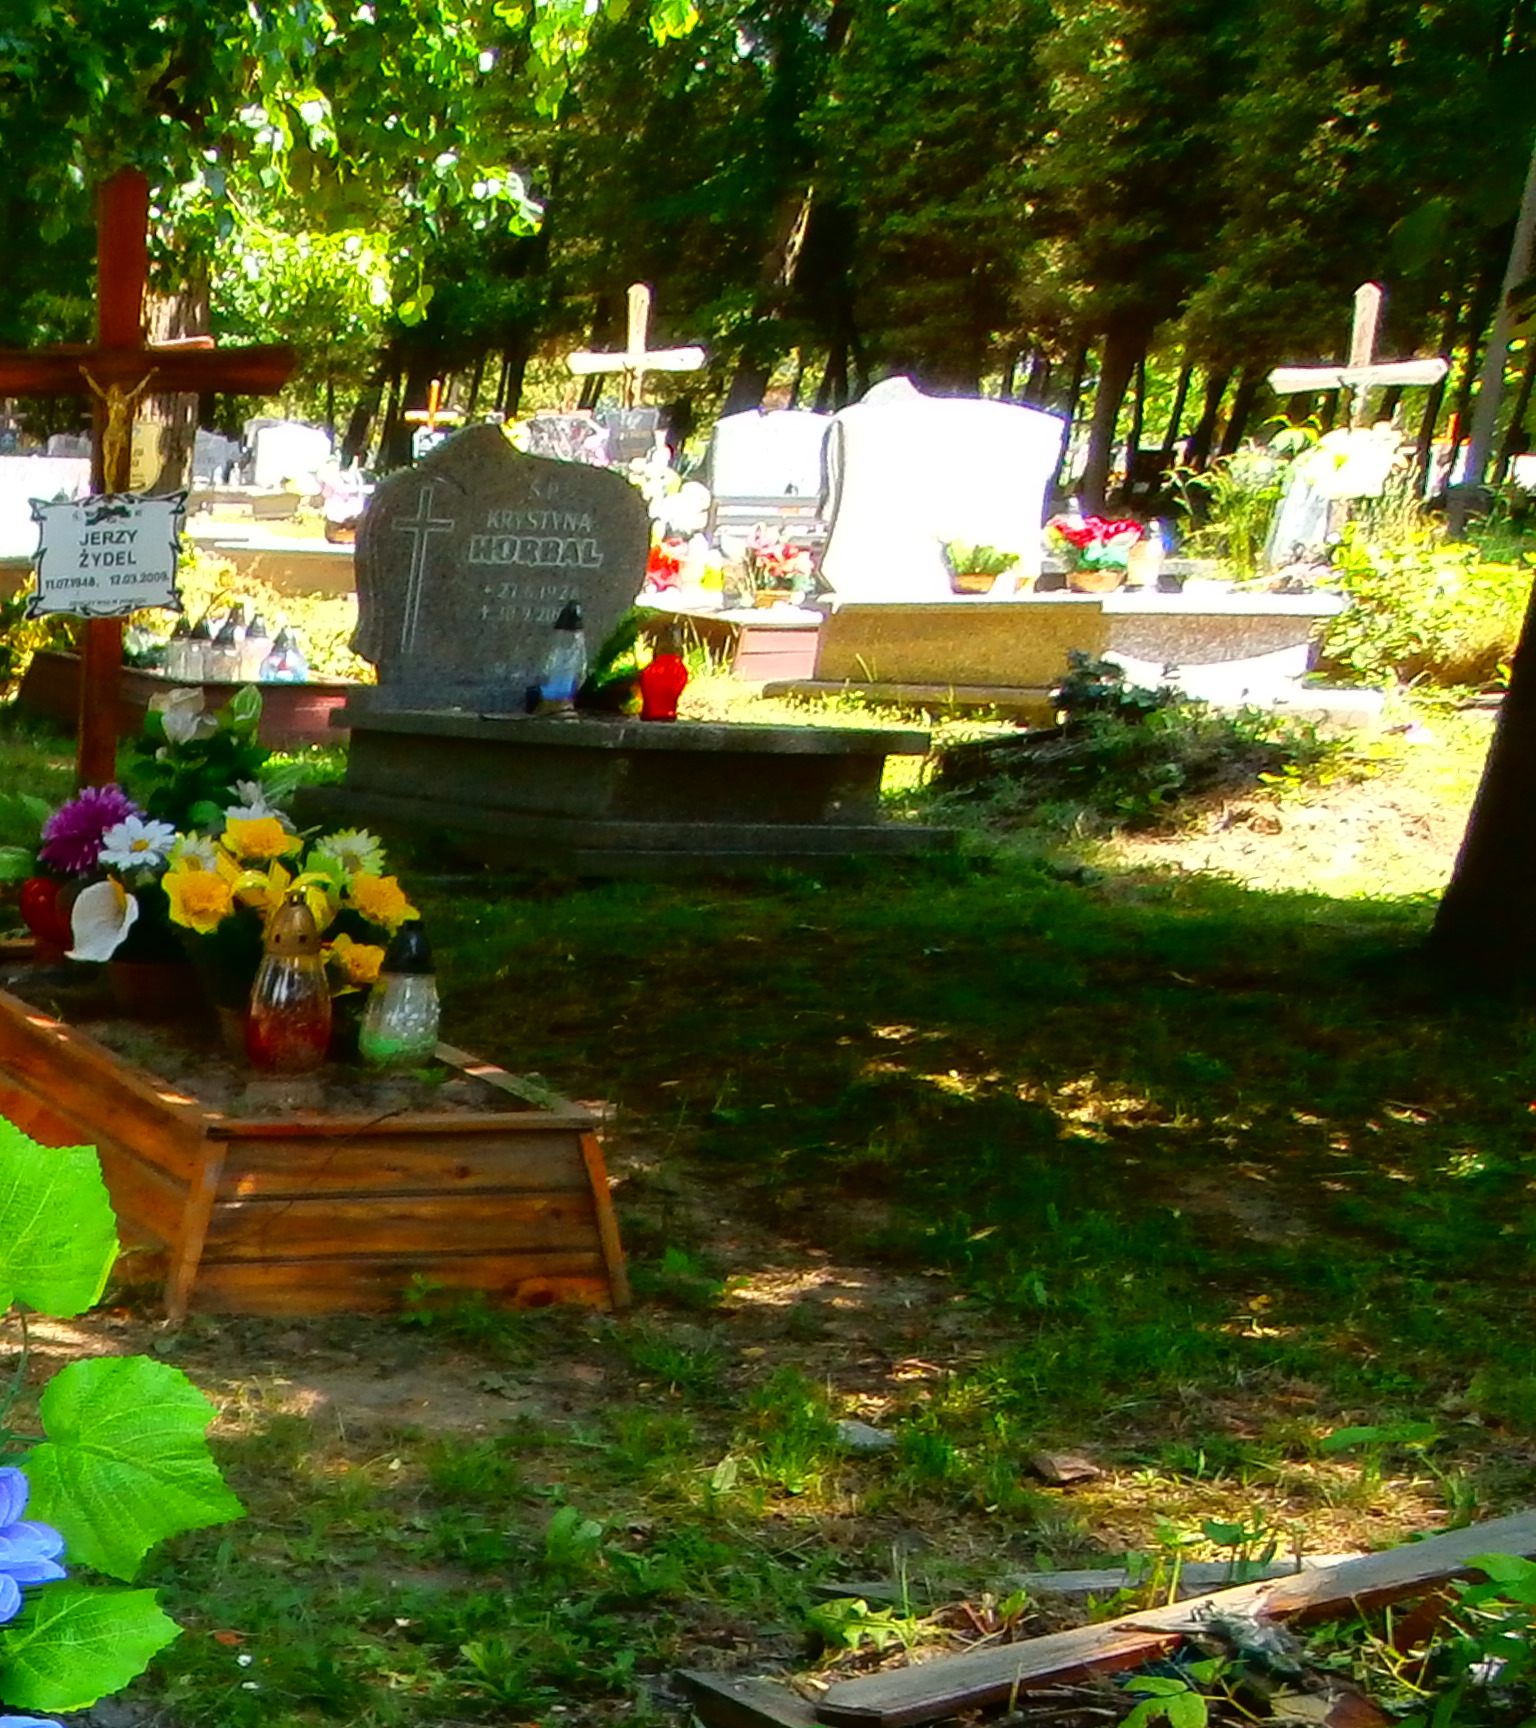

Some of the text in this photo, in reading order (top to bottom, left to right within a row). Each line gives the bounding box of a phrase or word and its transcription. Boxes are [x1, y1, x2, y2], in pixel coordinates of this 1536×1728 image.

[486, 509, 592, 532] KRYSTYNA
[79, 529, 138, 547] JERZY
[79, 548, 136, 568] ŻYDEL
[469, 534, 604, 568] HORBAL
